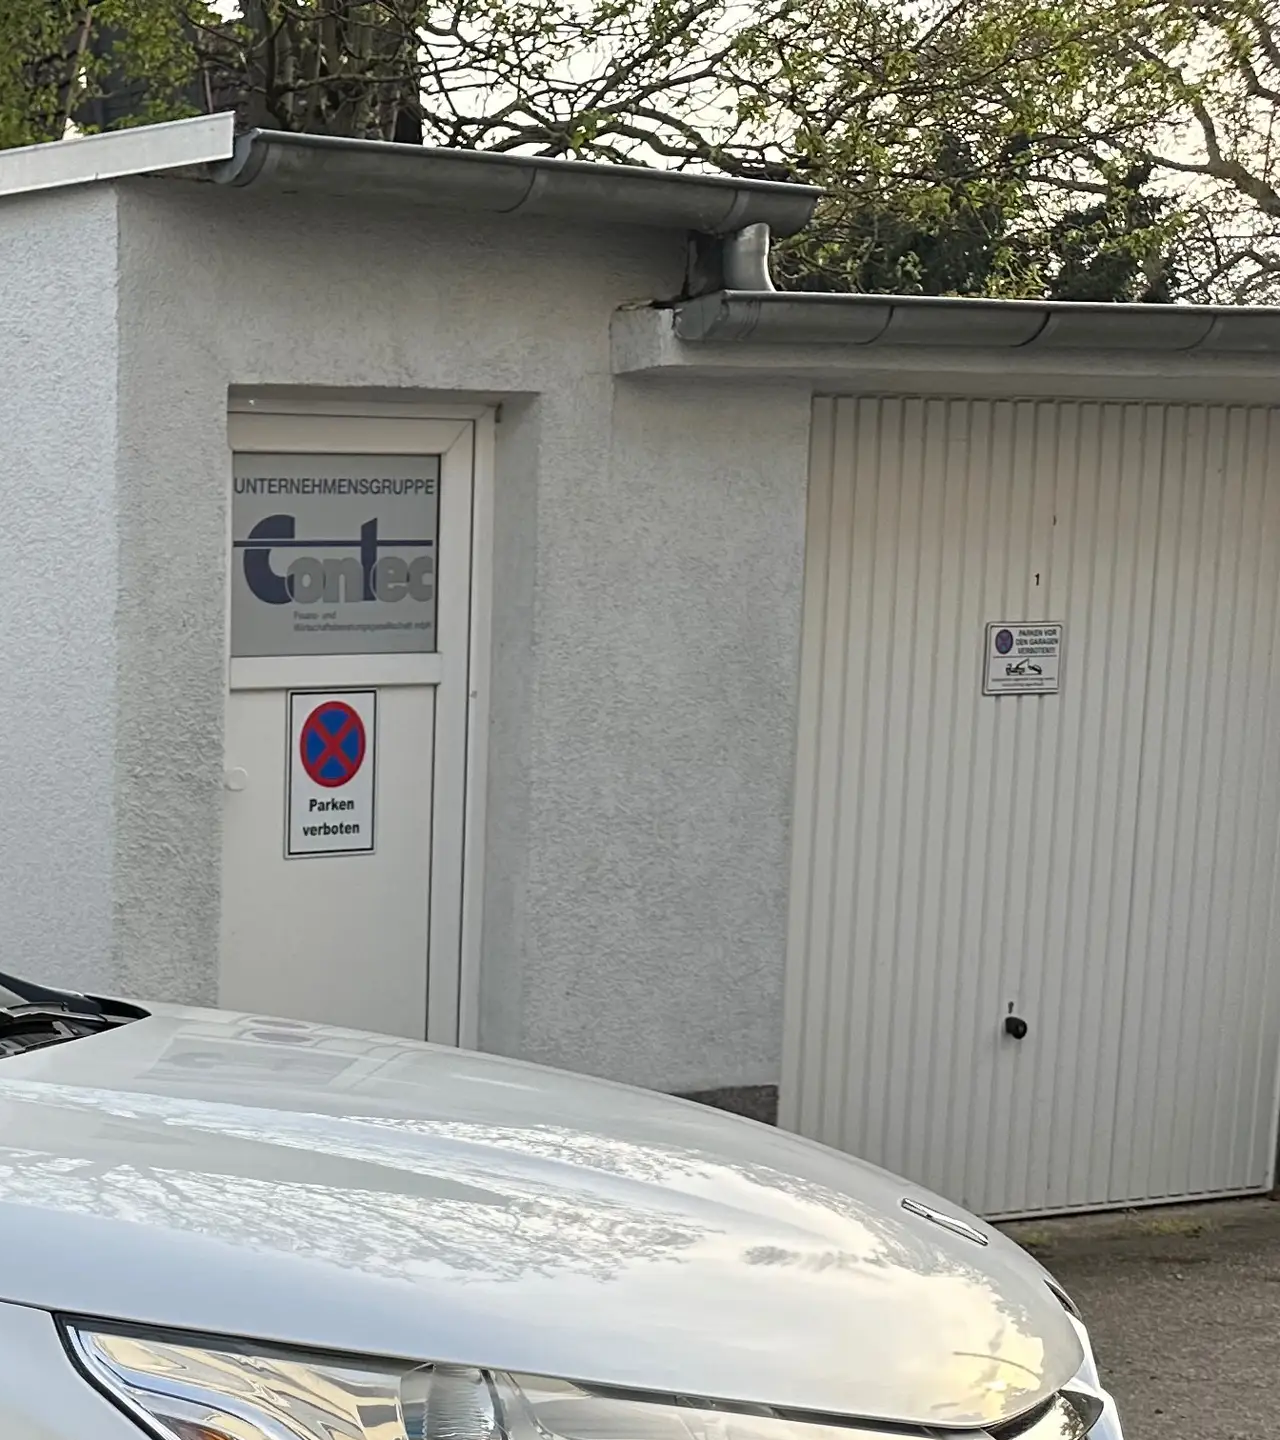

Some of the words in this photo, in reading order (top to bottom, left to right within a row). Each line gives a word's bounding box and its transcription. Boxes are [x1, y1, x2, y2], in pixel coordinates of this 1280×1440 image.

[234, 478, 435, 495] UNTERNEHMENSGRUPPE
[233, 514, 434, 604] Contec
[309, 798, 355, 813] Parken
[302, 821, 360, 837] verboten
